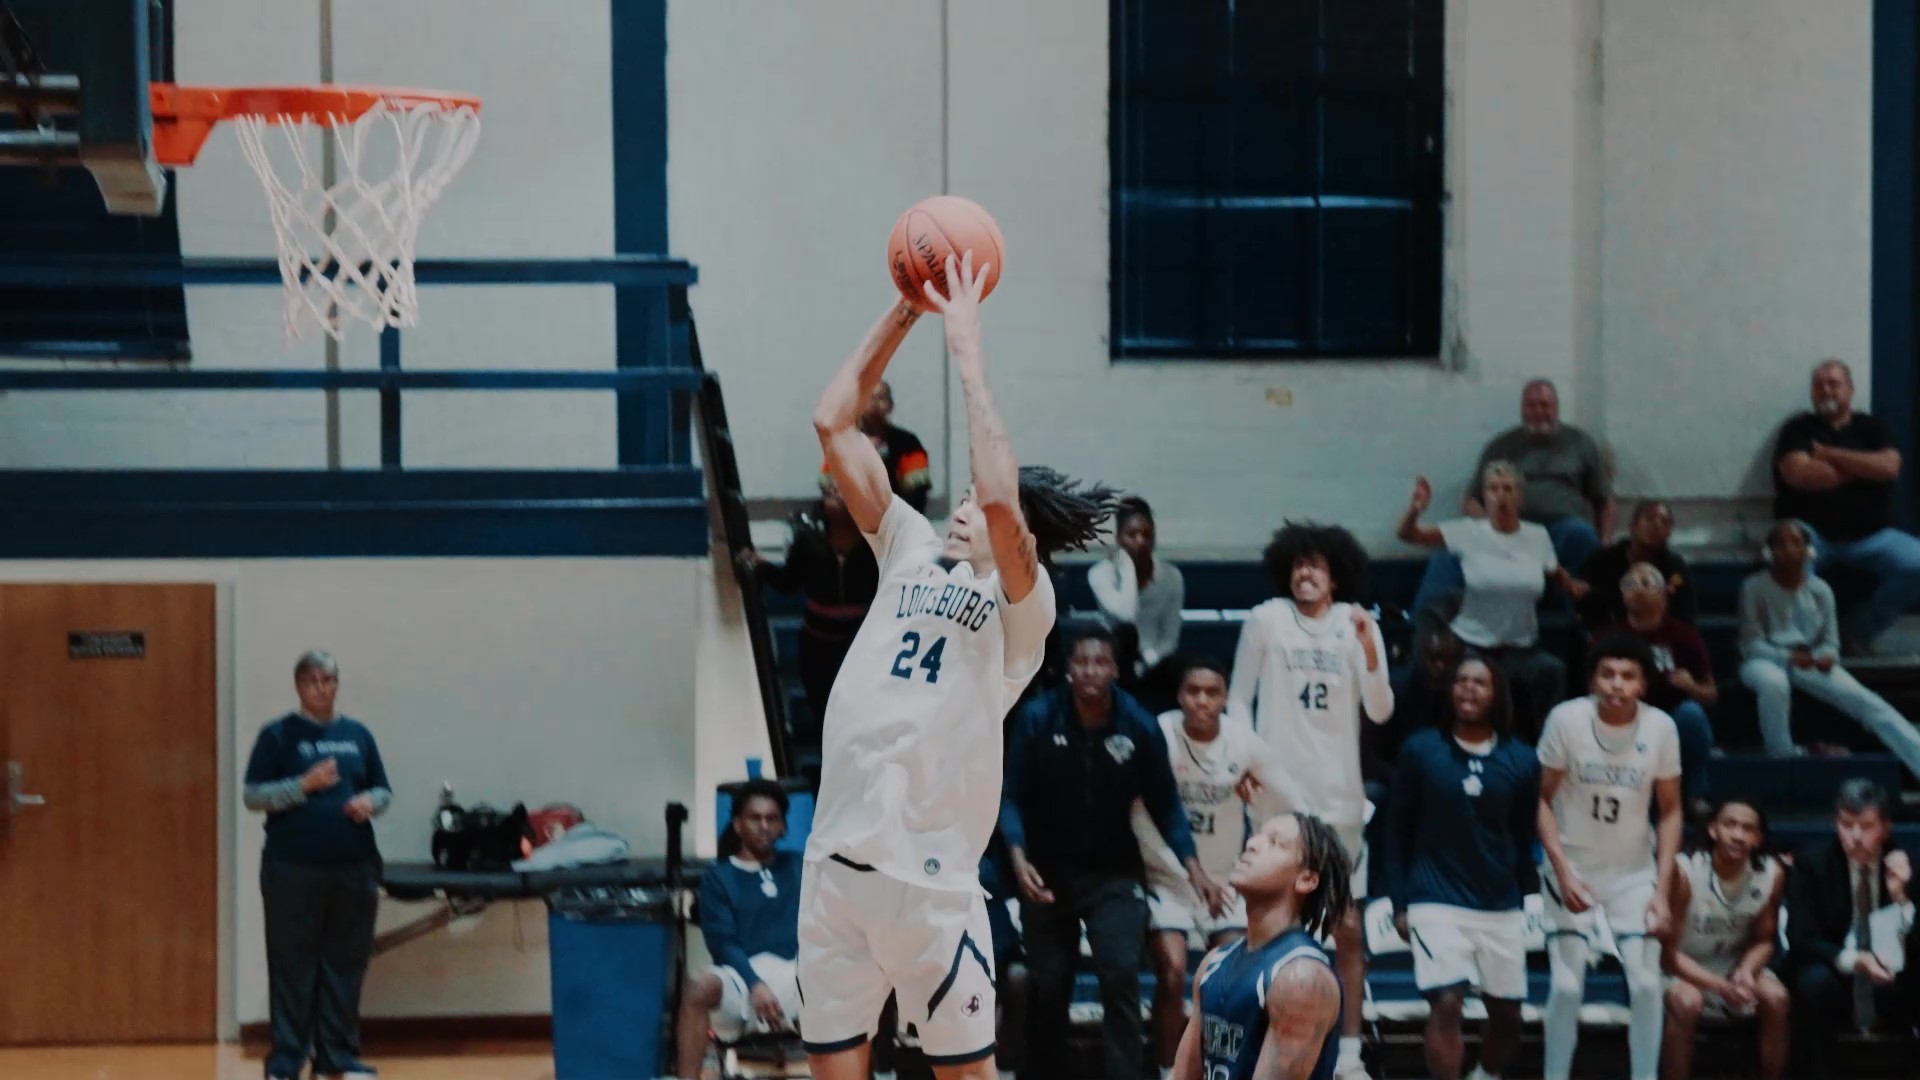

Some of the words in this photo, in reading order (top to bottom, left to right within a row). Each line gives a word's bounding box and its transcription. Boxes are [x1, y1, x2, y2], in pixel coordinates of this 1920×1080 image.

[890, 631, 947, 684] 24
[1298, 681, 1329, 710] 42
[1189, 810, 1216, 834] 21
[1591, 793, 1621, 824] 13
